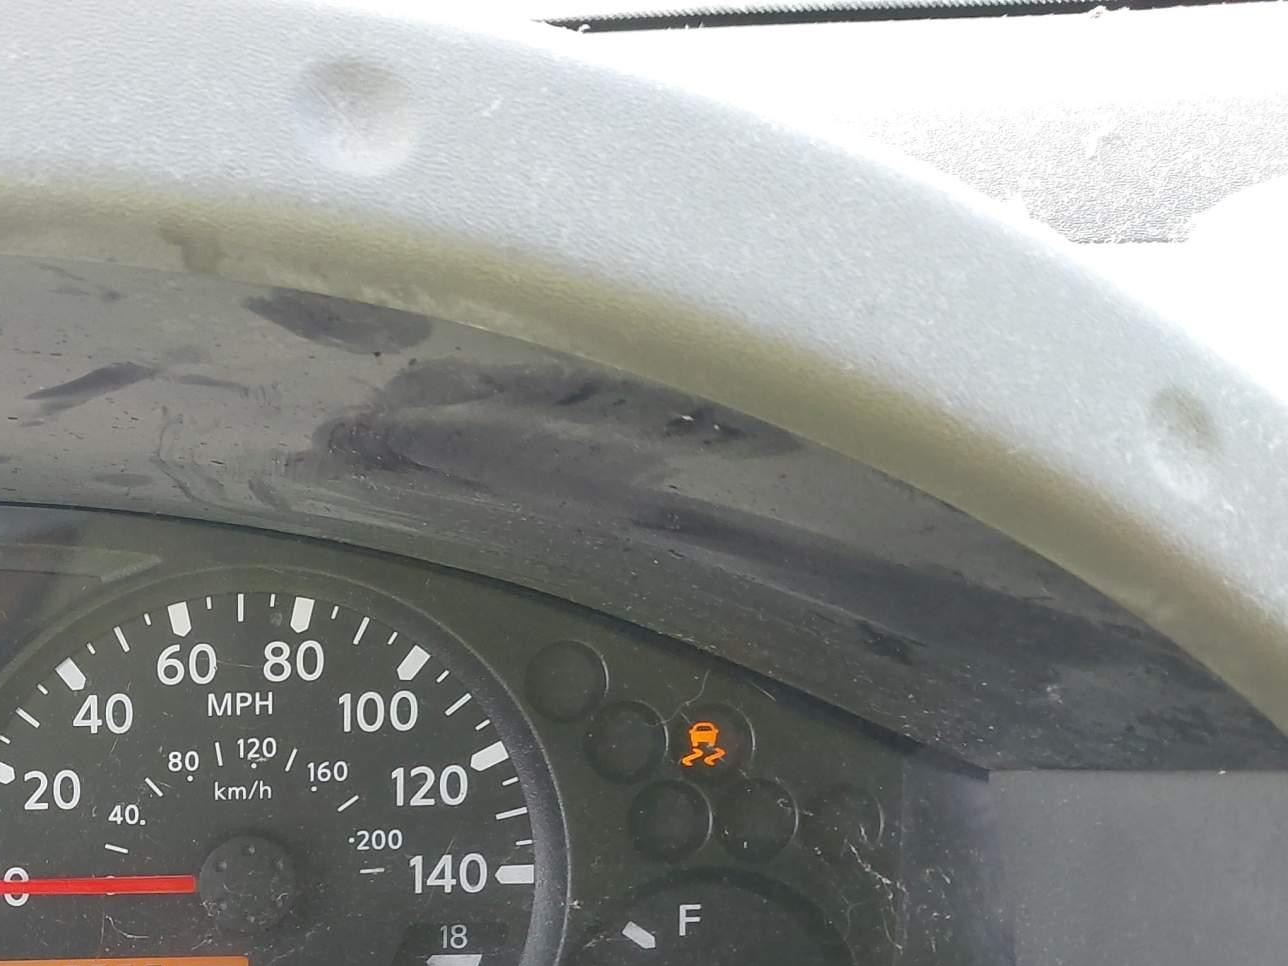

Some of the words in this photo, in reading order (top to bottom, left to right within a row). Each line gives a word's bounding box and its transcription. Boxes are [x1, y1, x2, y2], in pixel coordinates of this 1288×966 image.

[157, 643, 218, 686] 60
[263, 640, 325, 682] 80
[73, 693, 134, 734] 40
[207, 691, 273, 717] MPH
[338, 690, 418, 733] 100
[168, 750, 200, 772] 80
[237, 737, 277, 759] 120
[307, 760, 348, 782] 160
[391, 764, 470, 807] 120
[24, 769, 81, 810] 20
[214, 780, 272, 801] km/h
[108, 804, 140, 825] 40
[356, 829, 403, 851] 200
[3, 866, 30, 907] 0
[409, 853, 488, 893] 140
[679, 903, 702, 936] F
[440, 925, 469, 949] 18
